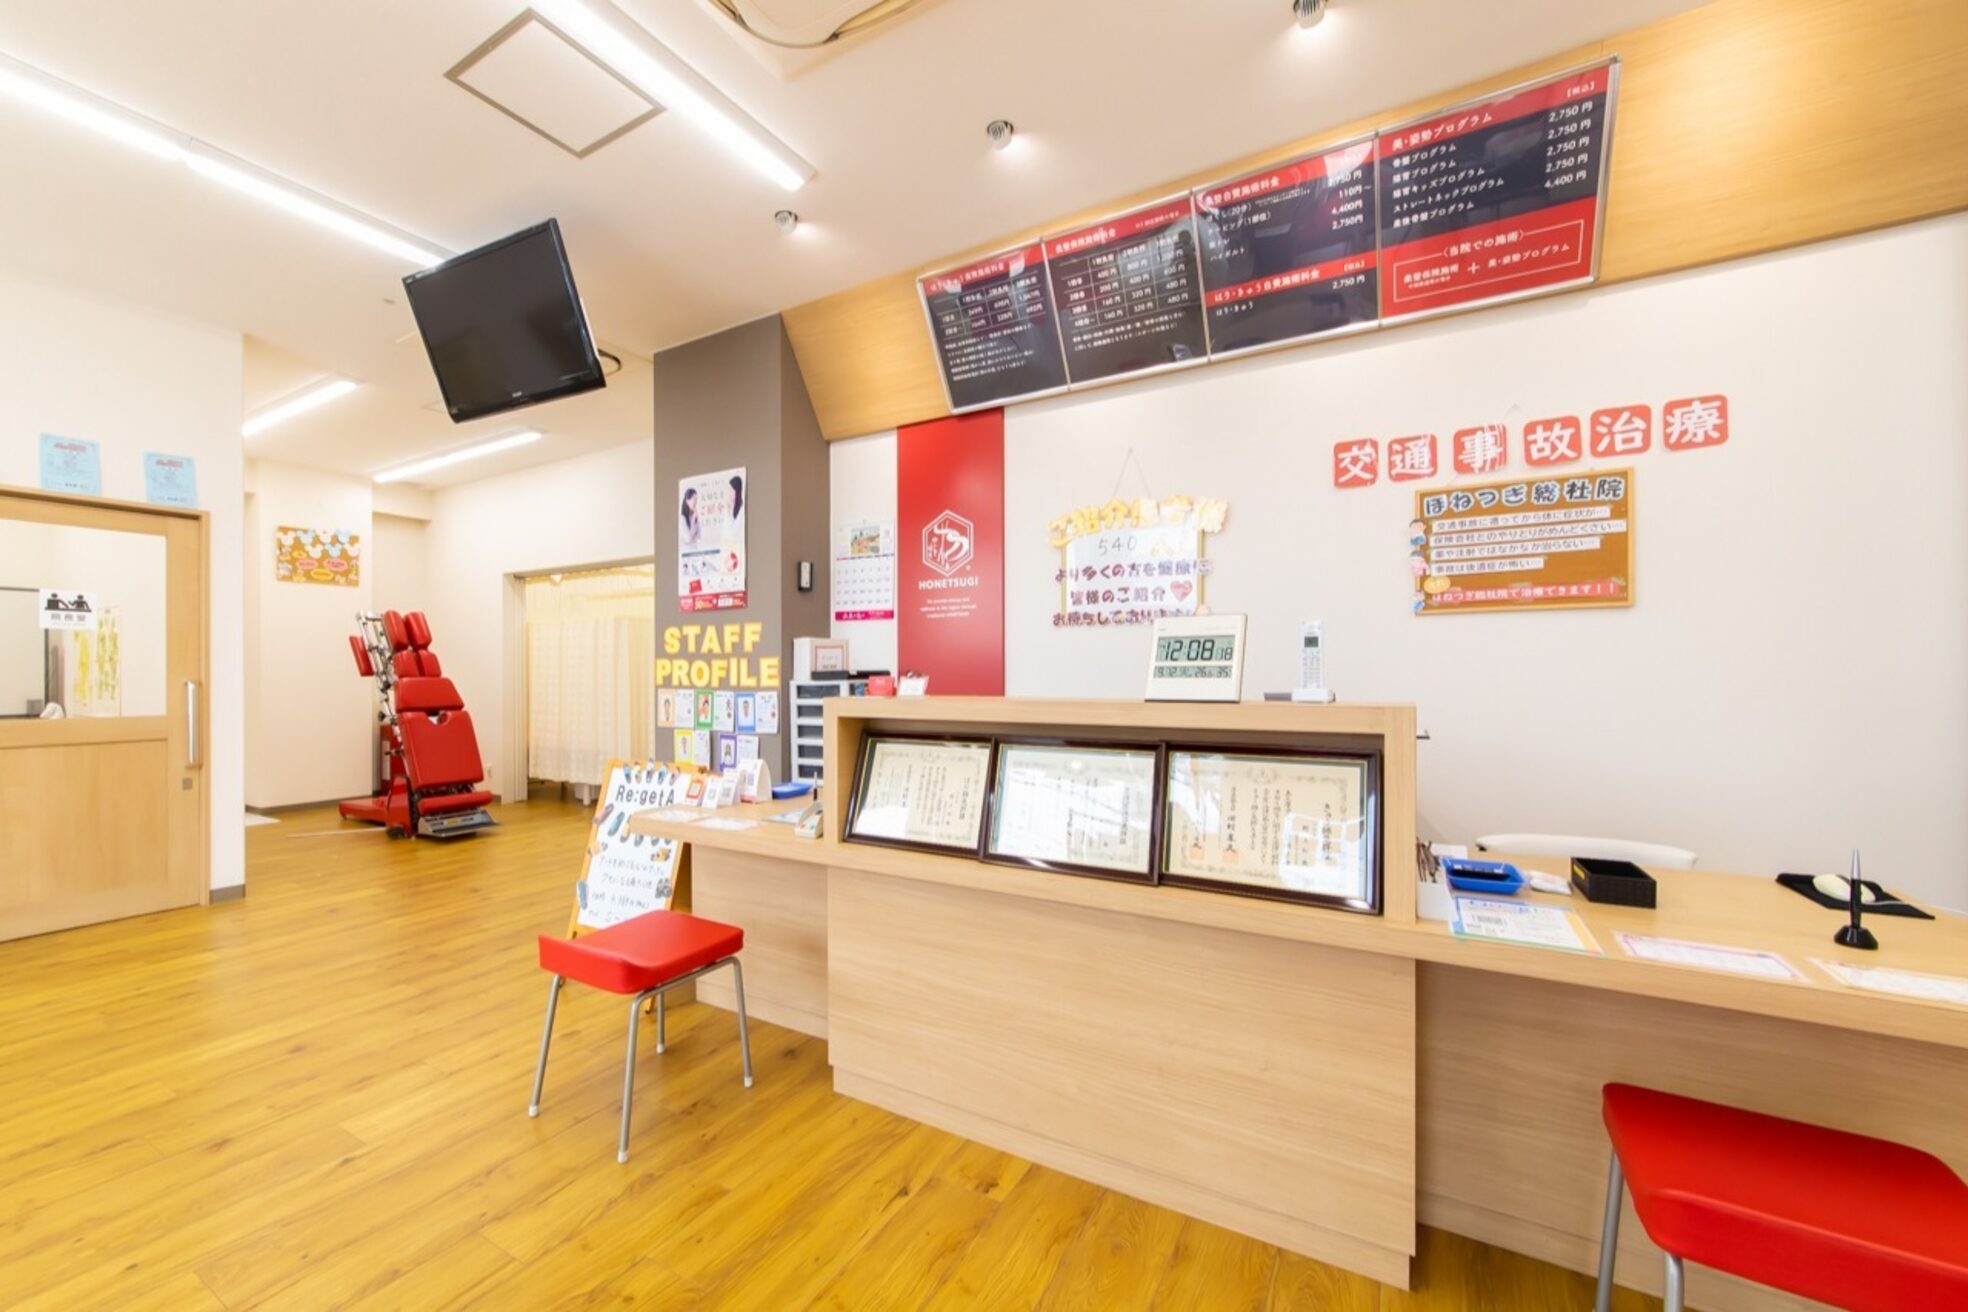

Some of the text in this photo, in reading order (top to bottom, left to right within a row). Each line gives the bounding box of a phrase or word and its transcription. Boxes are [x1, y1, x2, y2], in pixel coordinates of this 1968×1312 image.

[1336, 399, 1725, 484] 交通事故治療
[1425, 478, 1624, 516] ほねつぎ総社院
[918, 576, 978, 590] HONETSUGI
[1054, 560, 1212, 584] より多くの方を健康に
[1070, 585, 1166, 606] 皆様のご紹介
[664, 622, 762, 654] STAFF
[1165, 640, 1215, 662] 12:08
[656, 656, 780, 688] PROFILE
